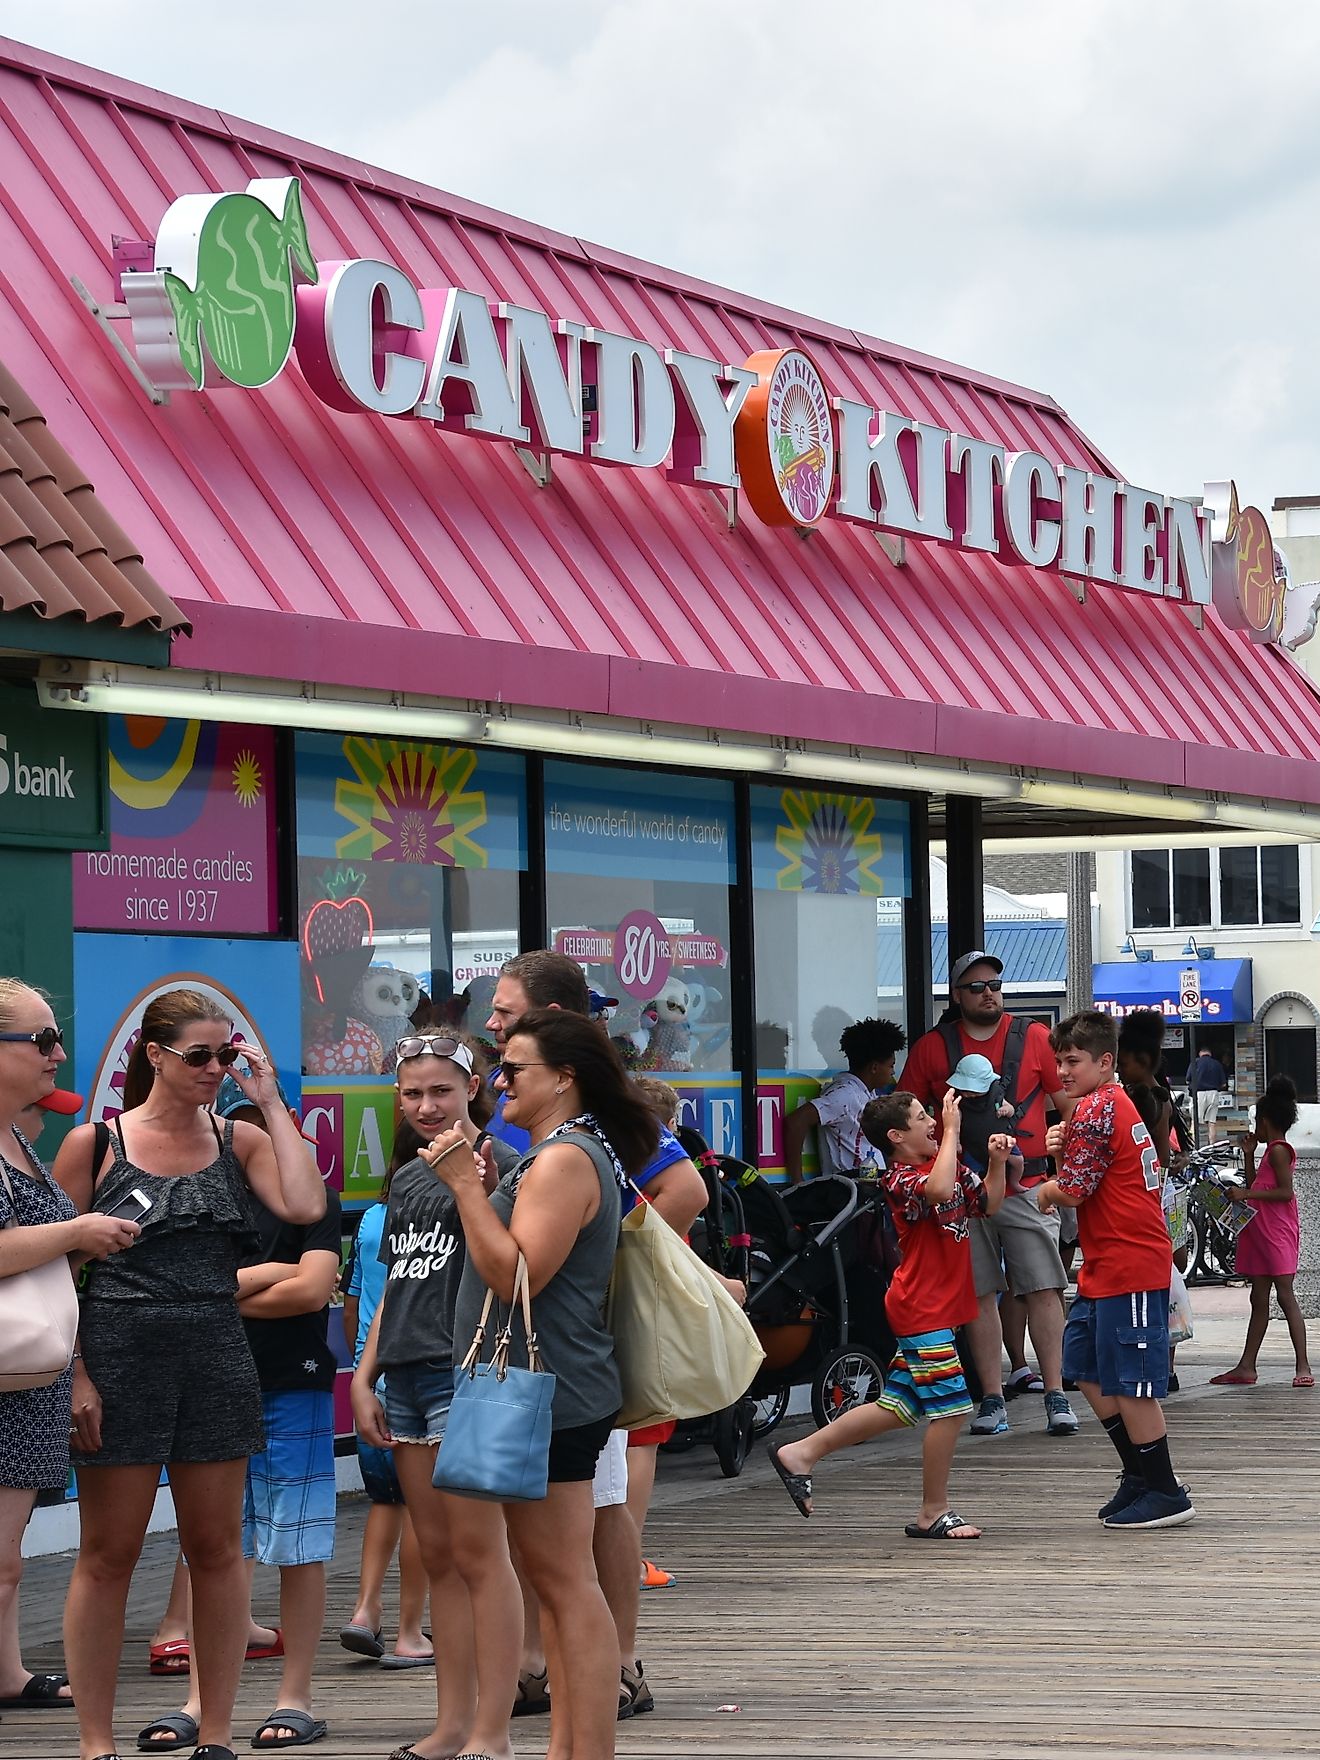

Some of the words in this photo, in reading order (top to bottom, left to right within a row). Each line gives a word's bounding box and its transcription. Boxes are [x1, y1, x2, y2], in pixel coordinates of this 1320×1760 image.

[771, 359, 791, 427] CANDY
[793, 358, 830, 443] KITCHEN
[322, 258, 760, 488] CANDY
[832, 396, 1217, 606] KITCHEN
[14, 752, 75, 799] bank
[550, 802, 571, 832] the
[574, 809, 637, 839] wonderful
[639, 815, 675, 842] world
[677, 815, 691, 842] of
[692, 817, 726, 853] candy
[86, 848, 188, 880] homemade
[192, 850, 253, 882] candies
[125, 888, 169, 921] since
[177, 889, 219, 922] 1937
[473, 951, 513, 963] SUBS
[563, 936, 612, 957] CELEBRATING
[620, 925, 656, 986] 80
[678, 940, 717, 960] SWEETNESS
